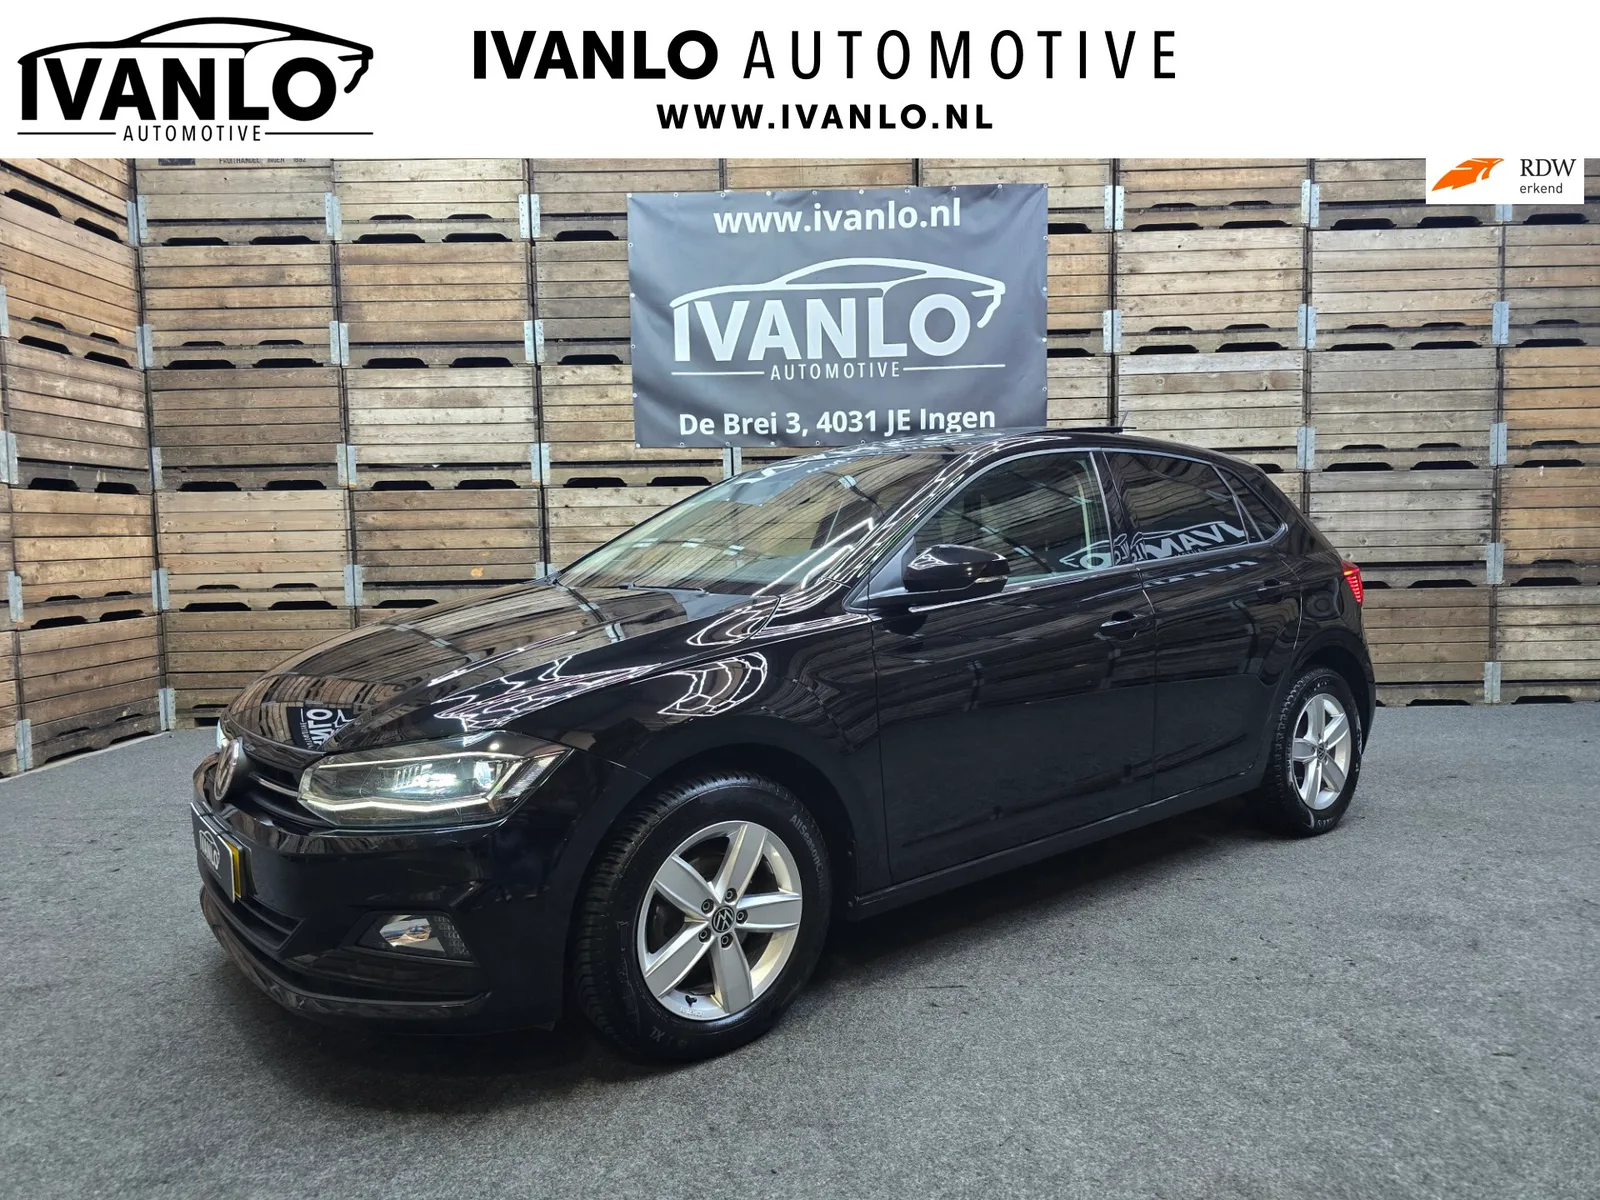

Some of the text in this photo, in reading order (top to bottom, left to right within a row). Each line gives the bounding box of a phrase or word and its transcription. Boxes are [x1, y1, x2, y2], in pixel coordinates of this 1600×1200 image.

[713, 197, 961, 234] www.ivanlo.nl
[673, 294, 971, 362] IVANLO
[770, 361, 900, 381] AUTOMOTIVE
[679, 408, 995, 437] De Brei 3, 4031 JE Ingen
